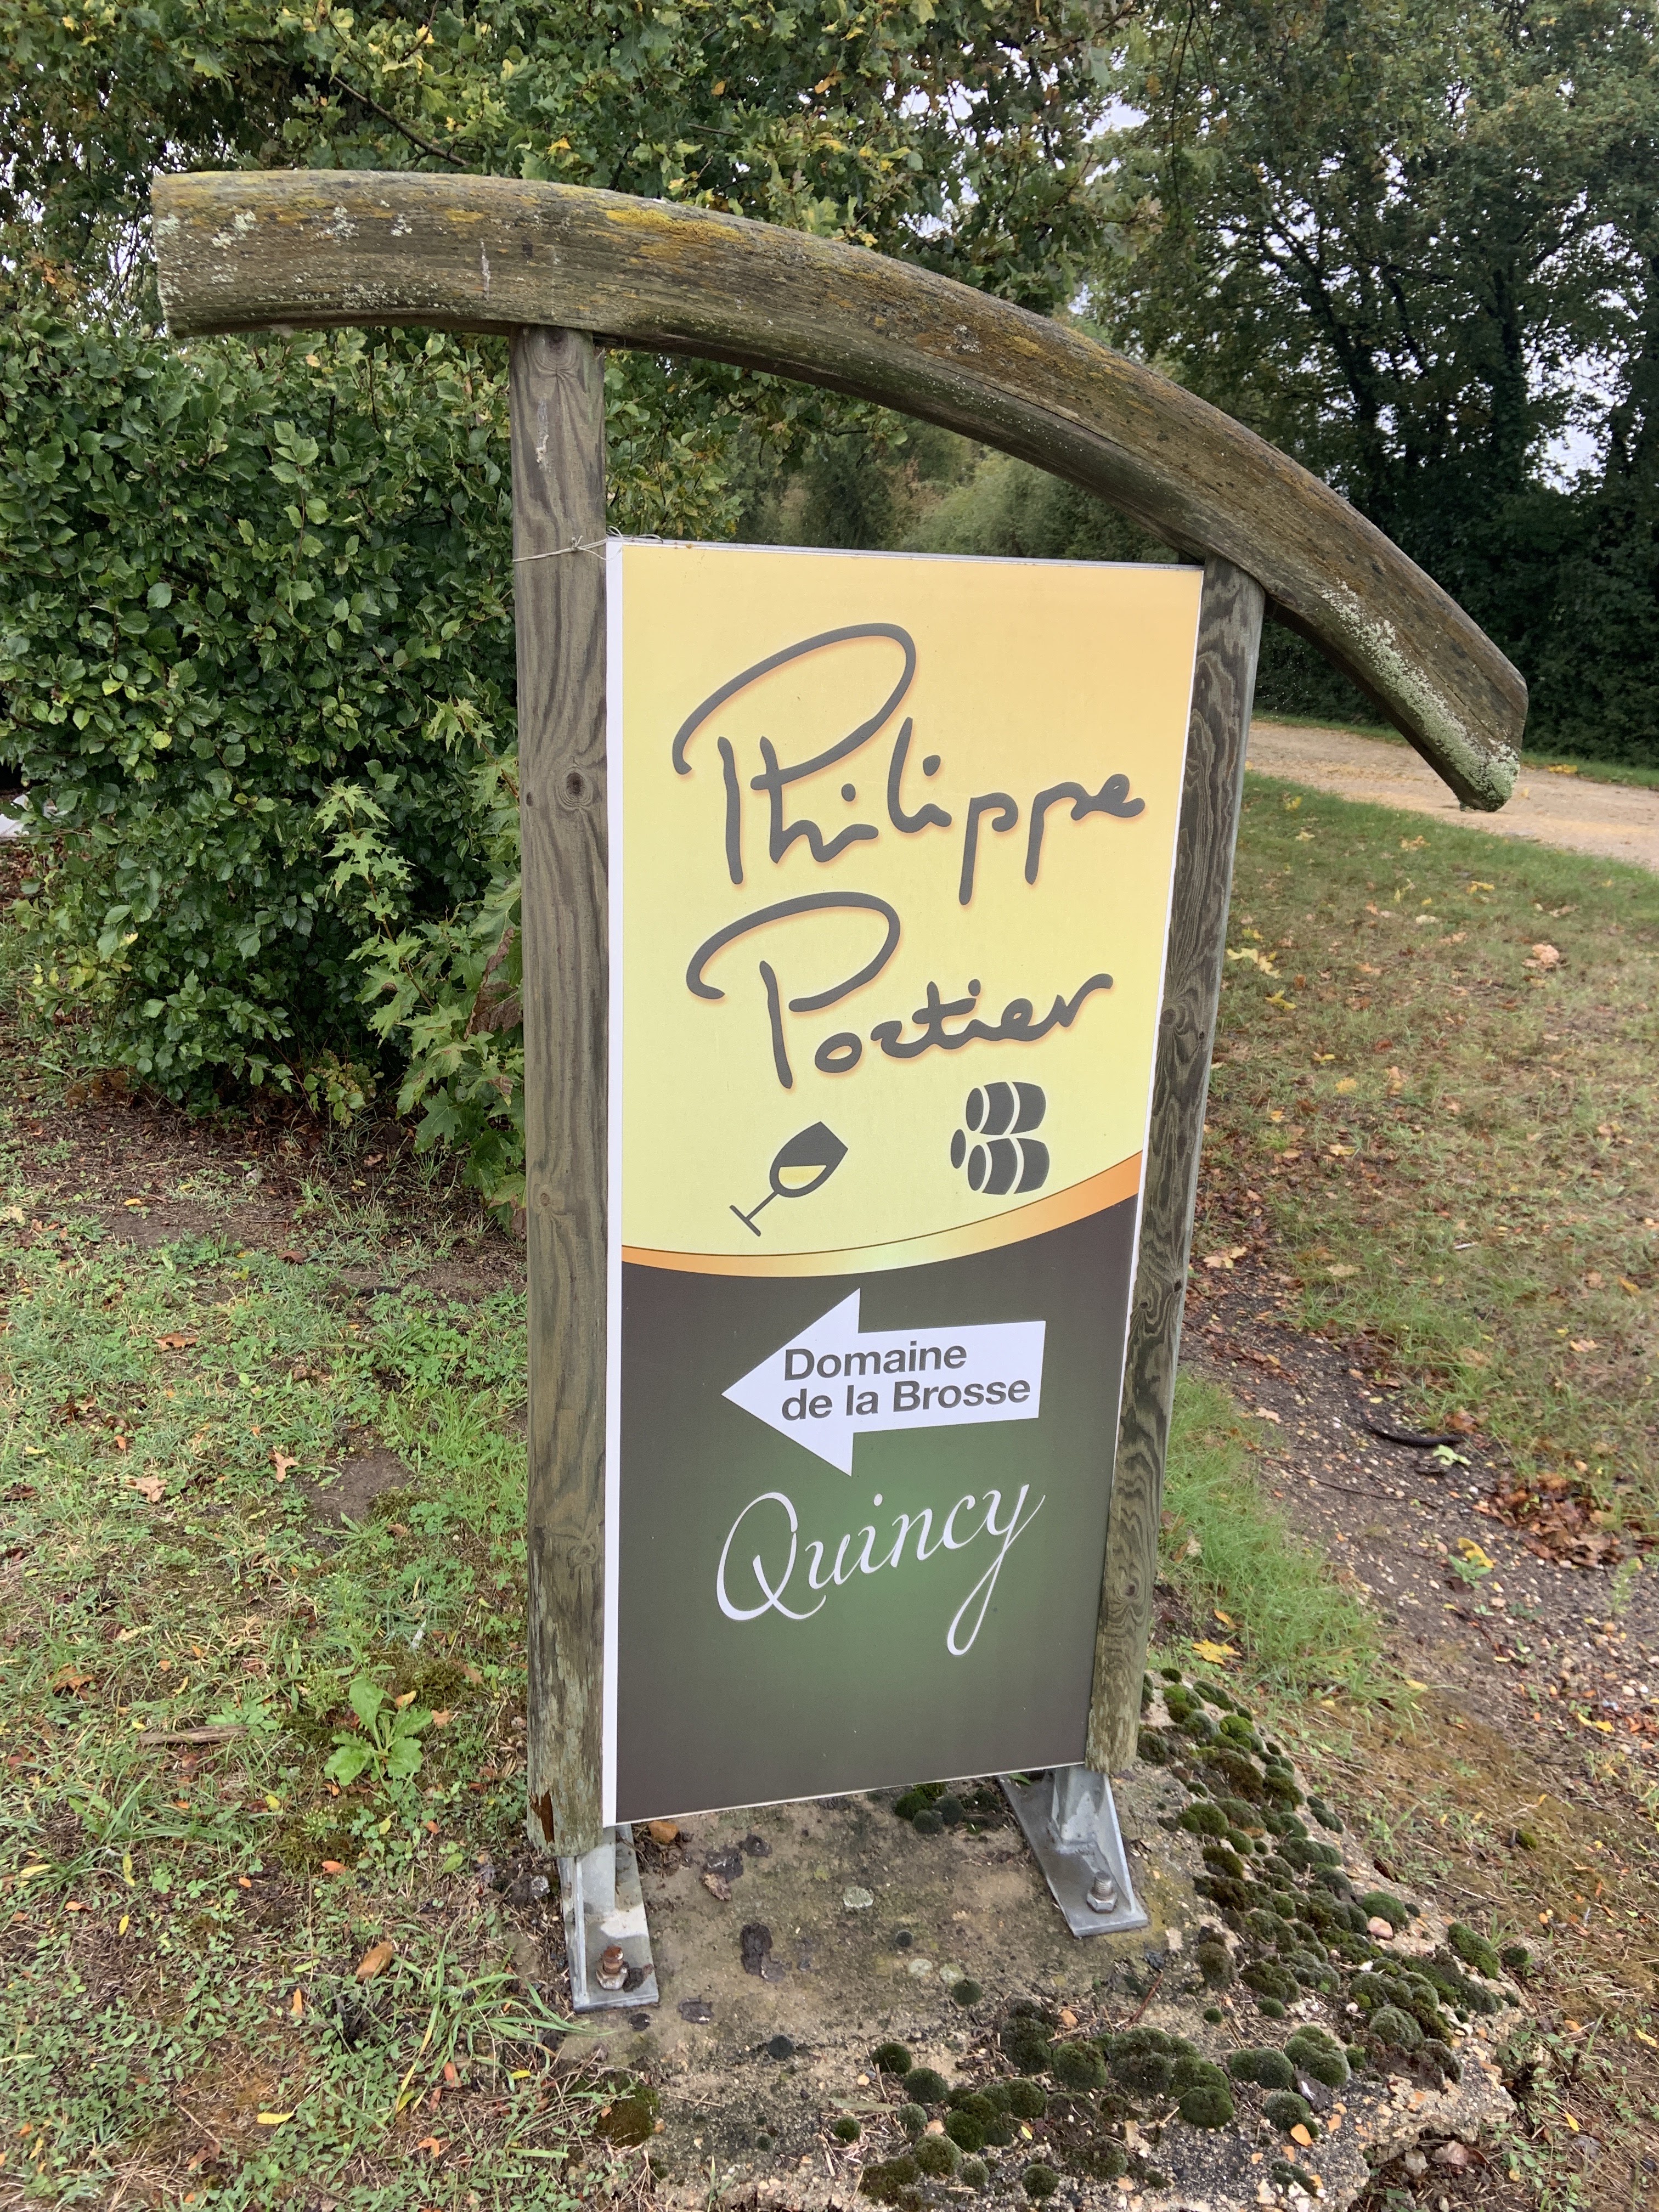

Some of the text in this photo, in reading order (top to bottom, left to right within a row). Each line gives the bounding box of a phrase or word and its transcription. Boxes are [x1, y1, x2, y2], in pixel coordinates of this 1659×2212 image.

[672, 623, 1146, 906] Philippe
[686, 891, 1114, 1090] Portier
[782, 1379, 1031, 1421] de la Brosse
[784, 1340, 967, 1381] Domaine
[716, 1483, 1046, 1656] Quincy
